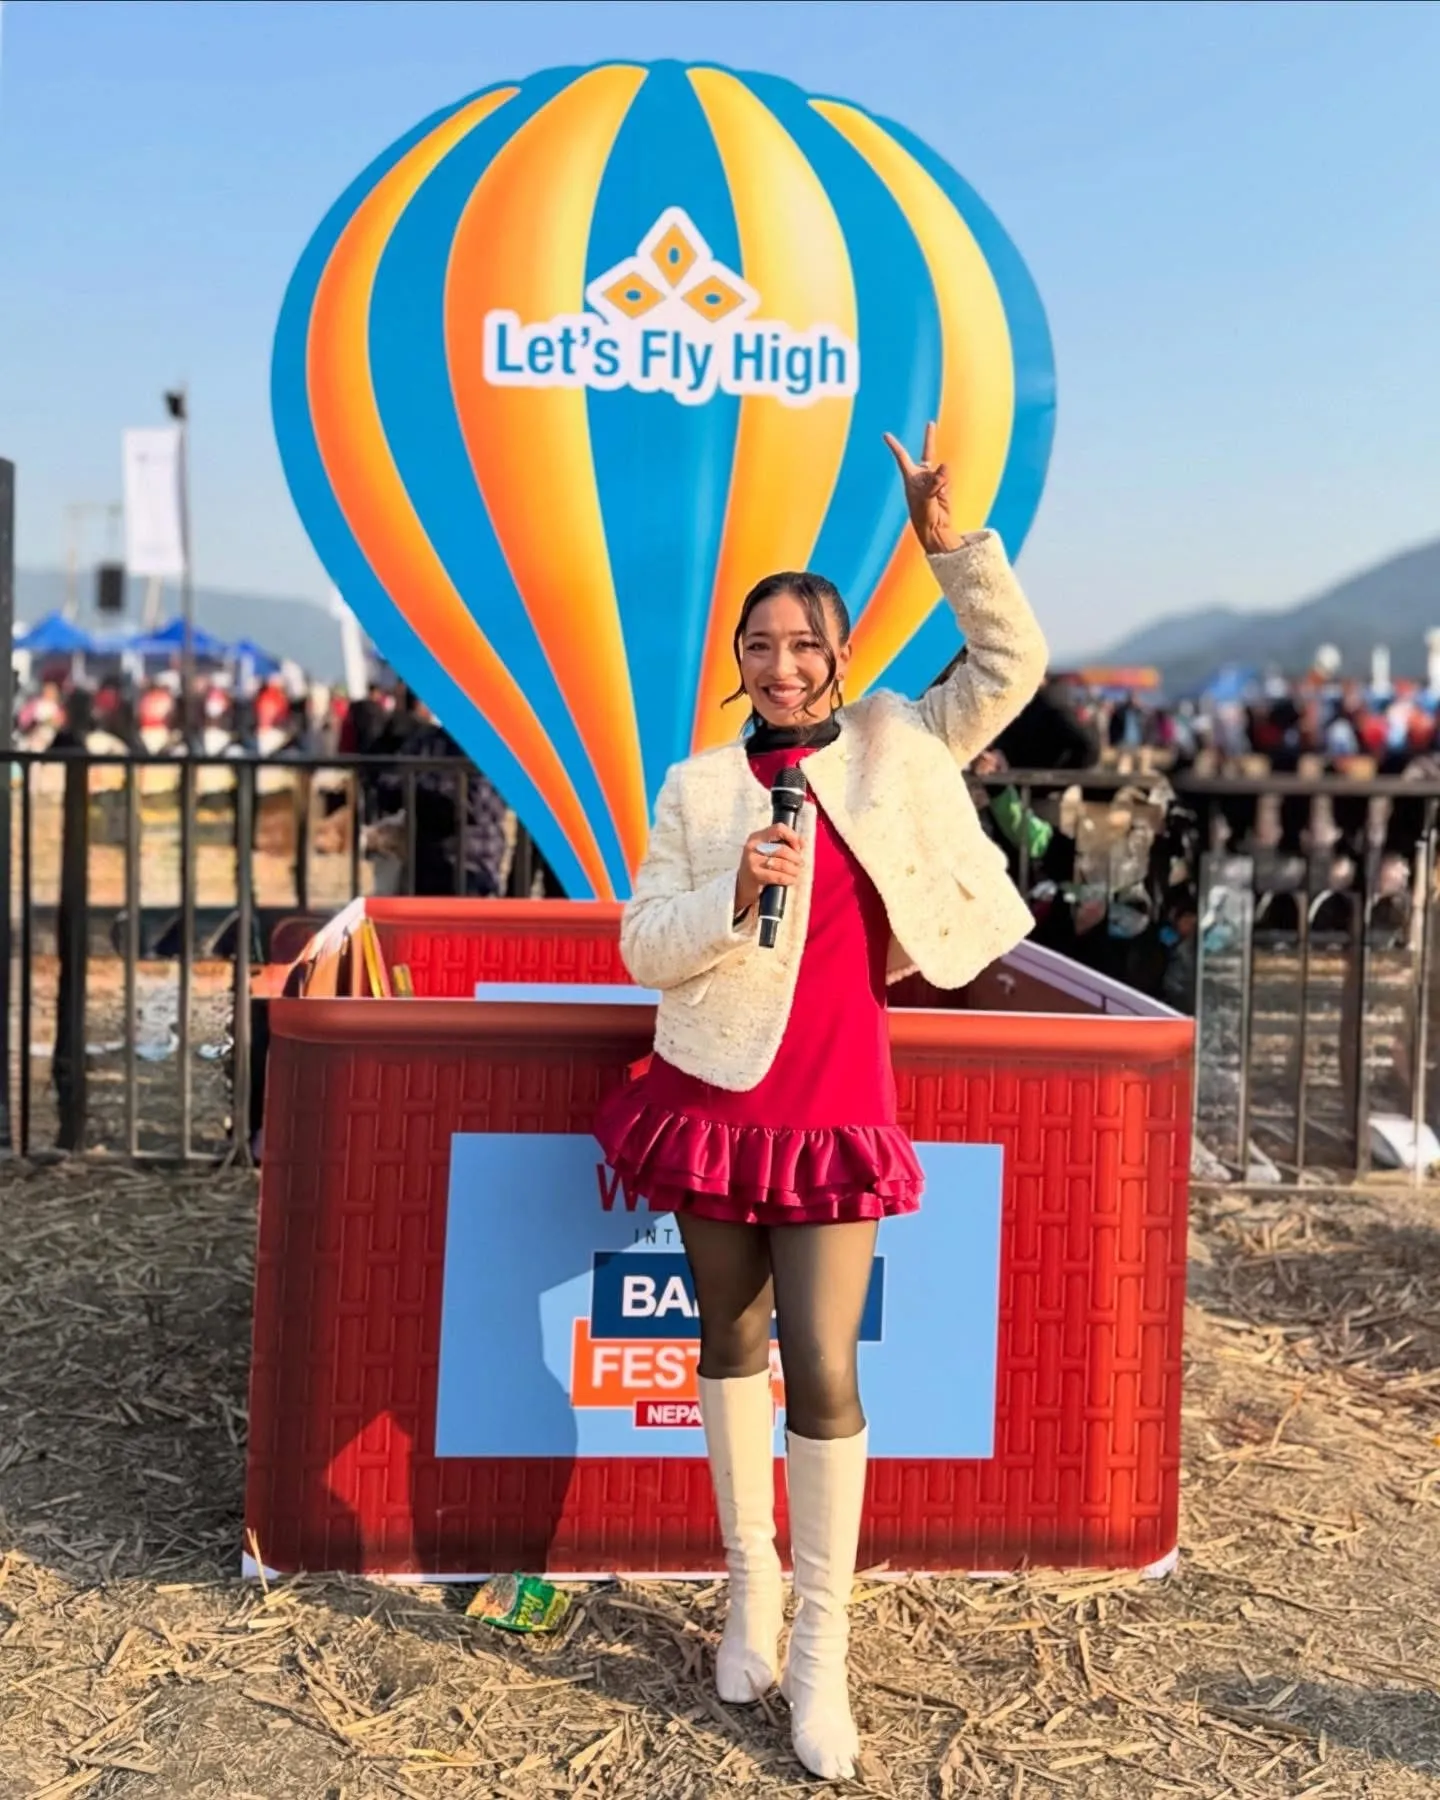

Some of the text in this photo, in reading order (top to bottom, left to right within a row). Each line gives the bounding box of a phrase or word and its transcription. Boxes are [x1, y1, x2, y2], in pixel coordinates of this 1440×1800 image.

[496, 323, 847, 395] Let's Fly High
[634, 1228, 685, 1244] INT
[621, 1275, 700, 1318] BA
[646, 1404, 703, 1425] NEPA
